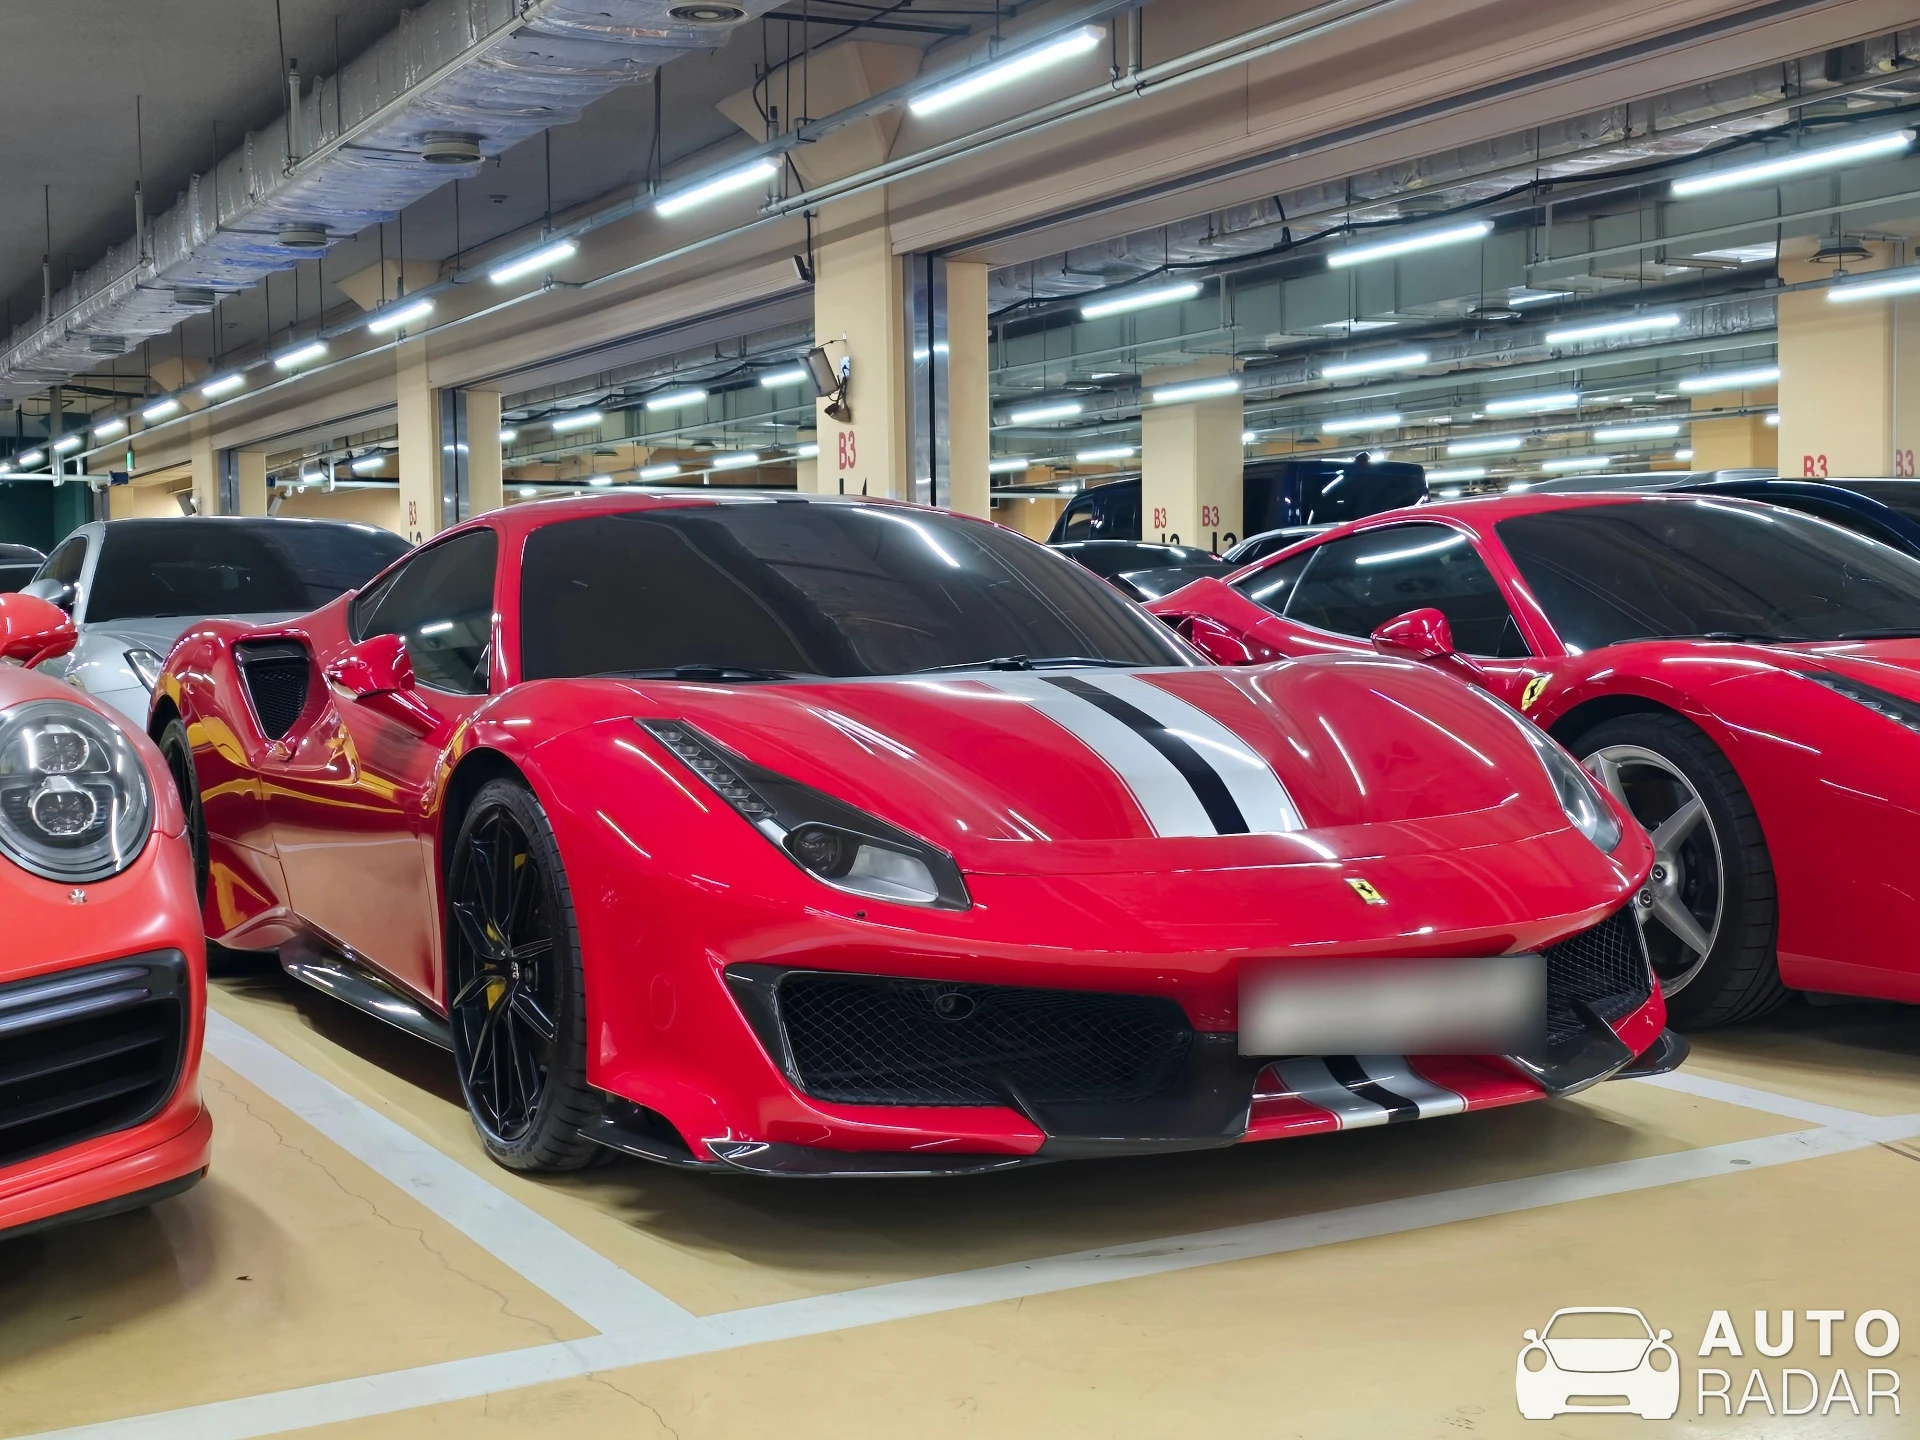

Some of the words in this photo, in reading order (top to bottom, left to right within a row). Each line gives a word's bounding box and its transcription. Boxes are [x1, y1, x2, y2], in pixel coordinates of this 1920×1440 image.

[839, 431, 856, 470] B3
[1803, 454, 1828, 477] B3
[1896, 449, 1914, 477] B3
[409, 501, 417, 526] B3
[1154, 508, 1166, 528] B3
[1202, 506, 1219, 527] B3
